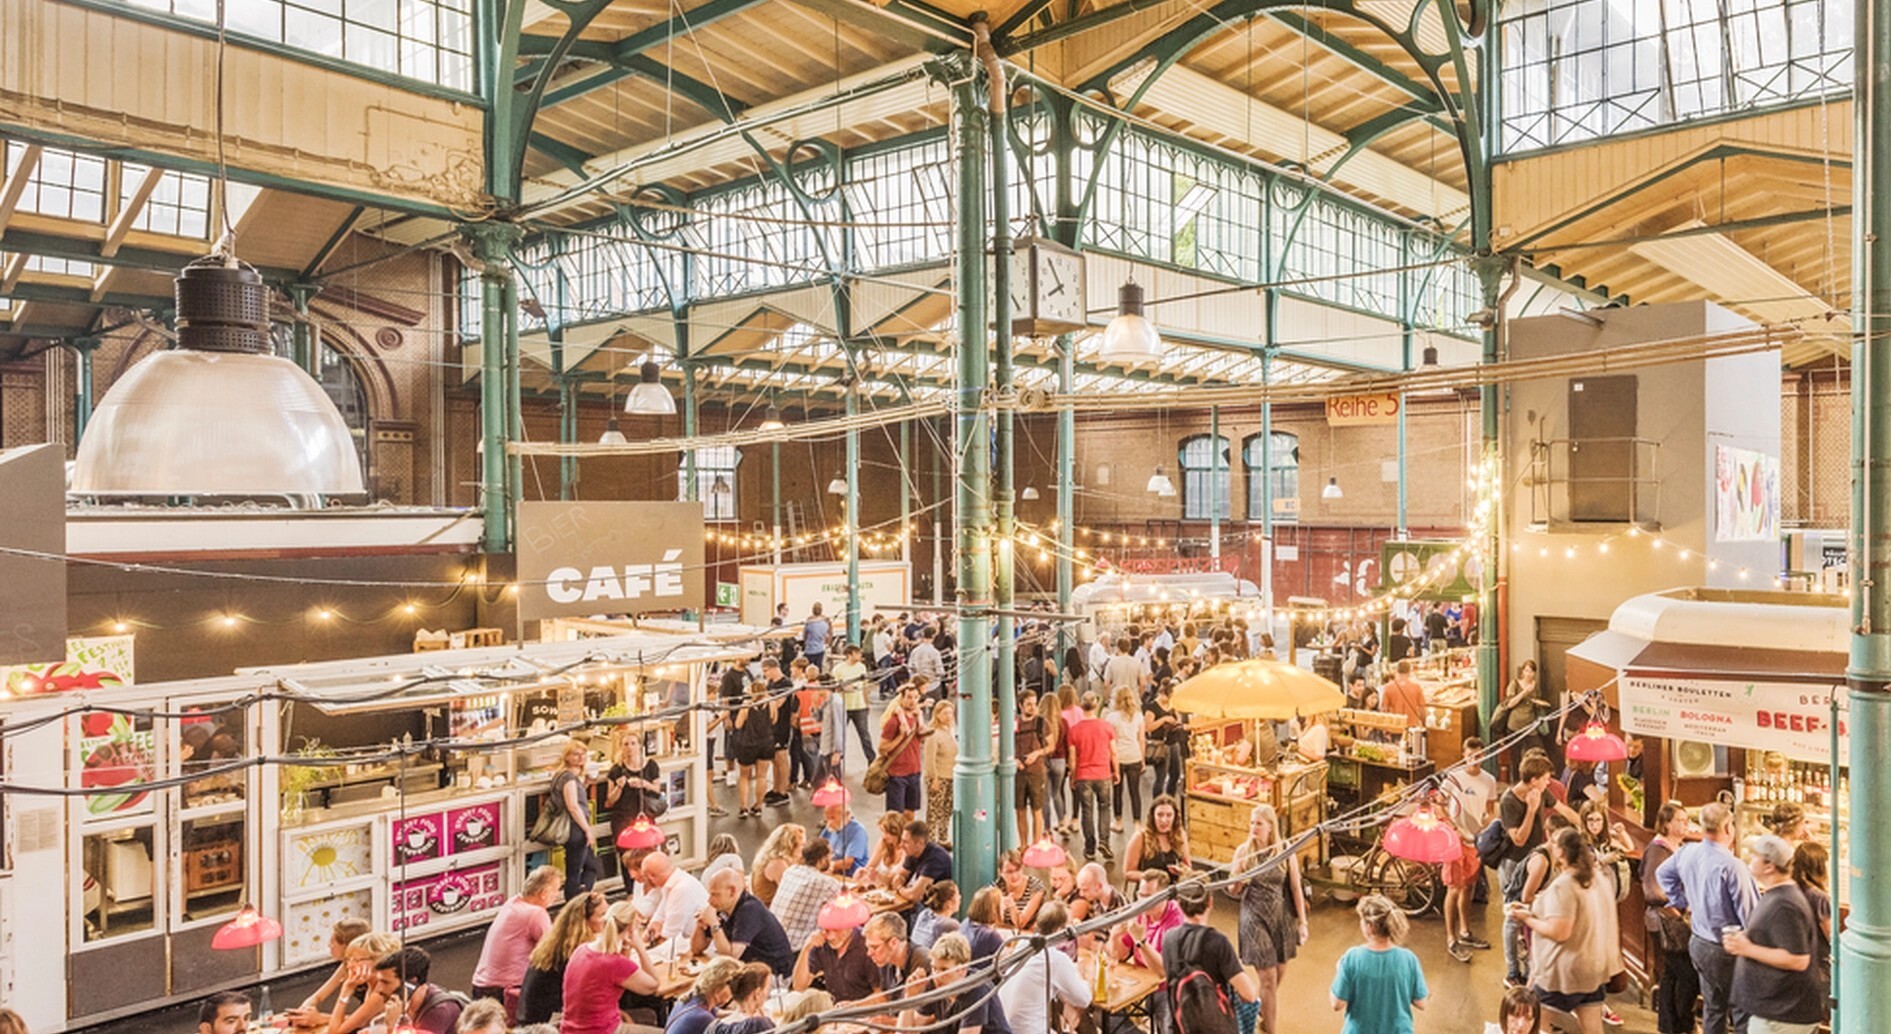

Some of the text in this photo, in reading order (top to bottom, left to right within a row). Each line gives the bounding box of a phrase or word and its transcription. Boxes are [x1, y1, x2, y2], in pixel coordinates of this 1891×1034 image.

[1327, 394, 1399, 417] Reihe 5
[522, 506, 591, 554] BIER
[546, 549, 684, 603] CAFÉ
[1630, 681, 1732, 698] BERLINER BOULETTEN
[1632, 705, 1733, 725] BERLIN BOLOGNA
